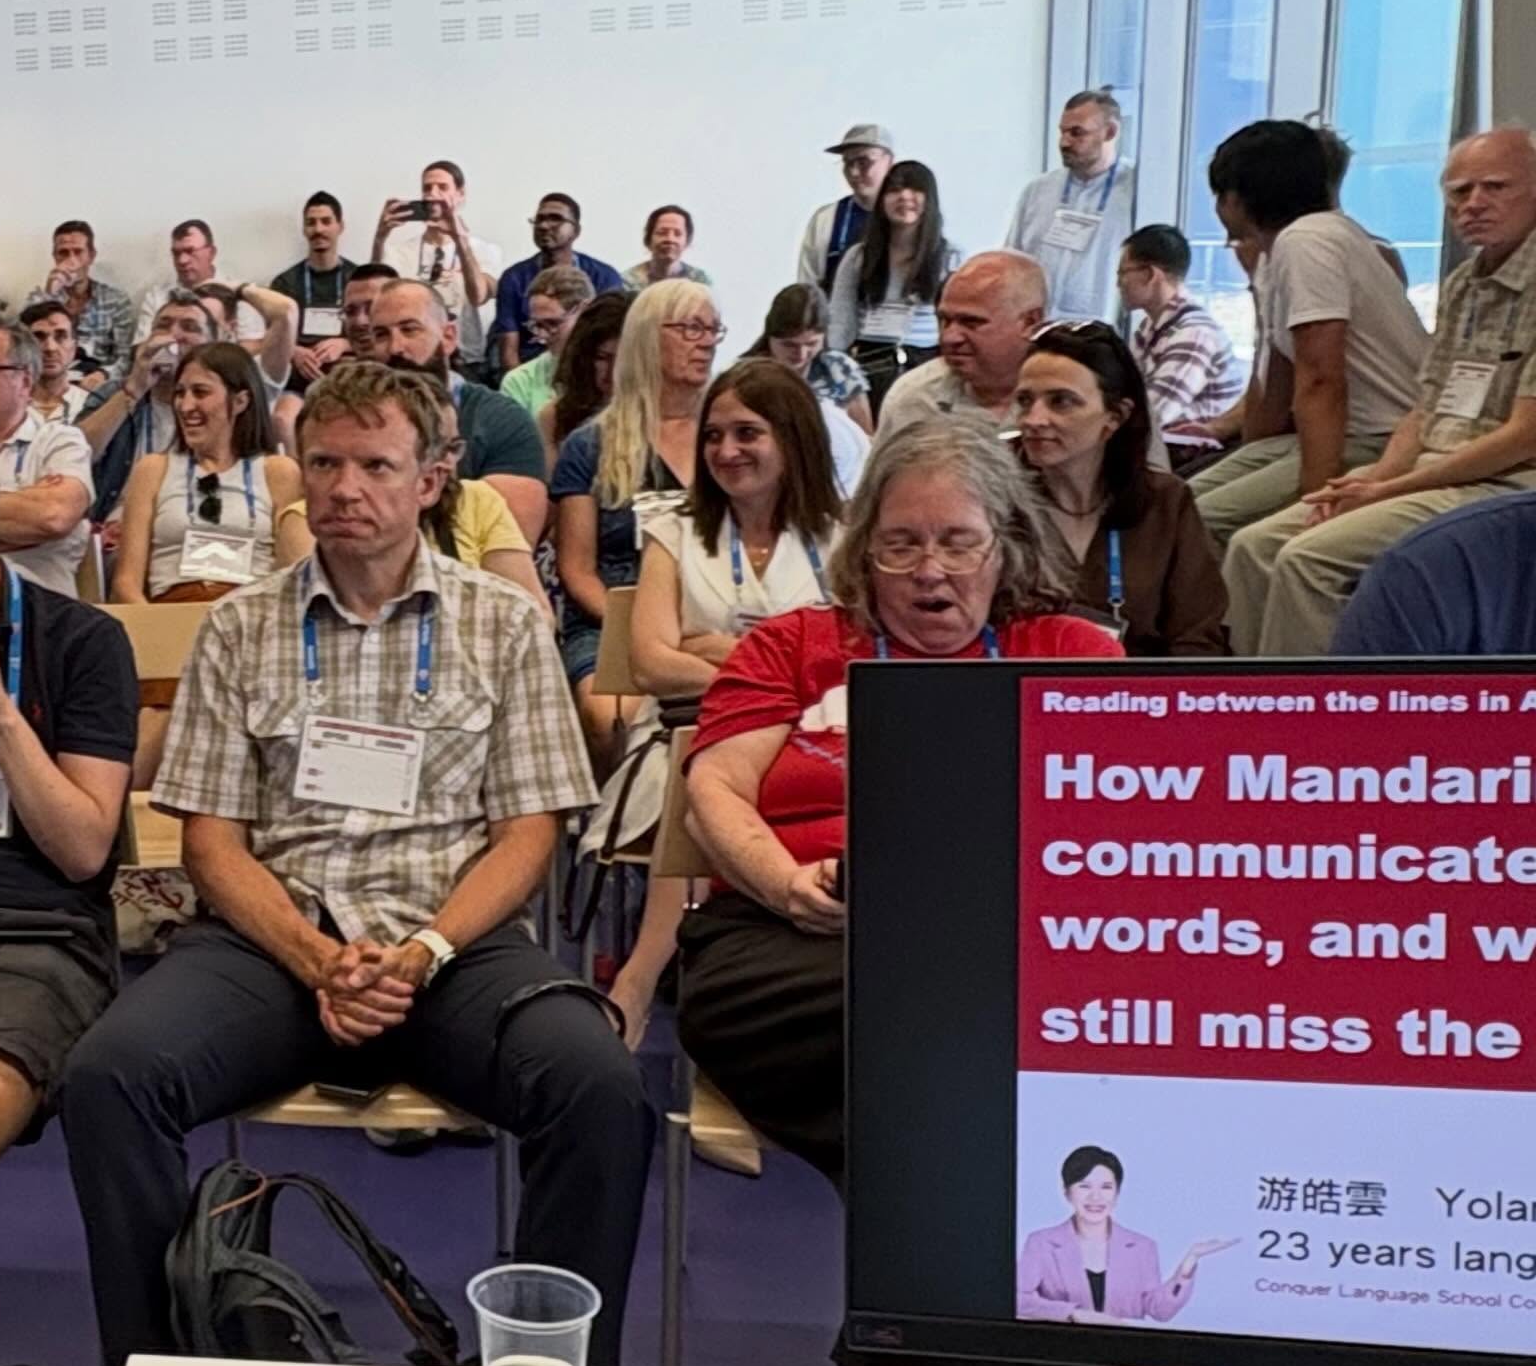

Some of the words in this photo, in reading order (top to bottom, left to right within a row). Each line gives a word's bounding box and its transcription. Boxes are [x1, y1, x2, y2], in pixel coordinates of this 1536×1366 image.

[1042, 691, 1168, 717] Reading
[1177, 691, 1315, 713] between
[1324, 691, 1379, 713] the
[1388, 690, 1469, 713] lines
[1478, 689, 1510, 713] in
[1043, 753, 1204, 801] How
[1227, 755, 1534, 804] Mandari
[1041, 833, 1536, 884] communicate
[1040, 907, 1285, 967] words,
[1308, 913, 1447, 961] and
[1472, 925, 1536, 963] w
[1040, 998, 1174, 1046] still
[1199, 1003, 1373, 1055] miss
[1396, 1009, 1523, 1060] the
[1257, 1176, 1388, 1217] 游皓雲
[1435, 1186, 1536, 1222] Yola
[1258, 1229, 1311, 1261] 23
[1327, 1241, 1436, 1269] years
[1454, 1241, 1536, 1281] lang
[1254, 1278, 1333, 1297] Conquer
[1338, 1284, 1431, 1304] Language
[1437, 1290, 1502, 1308] School
